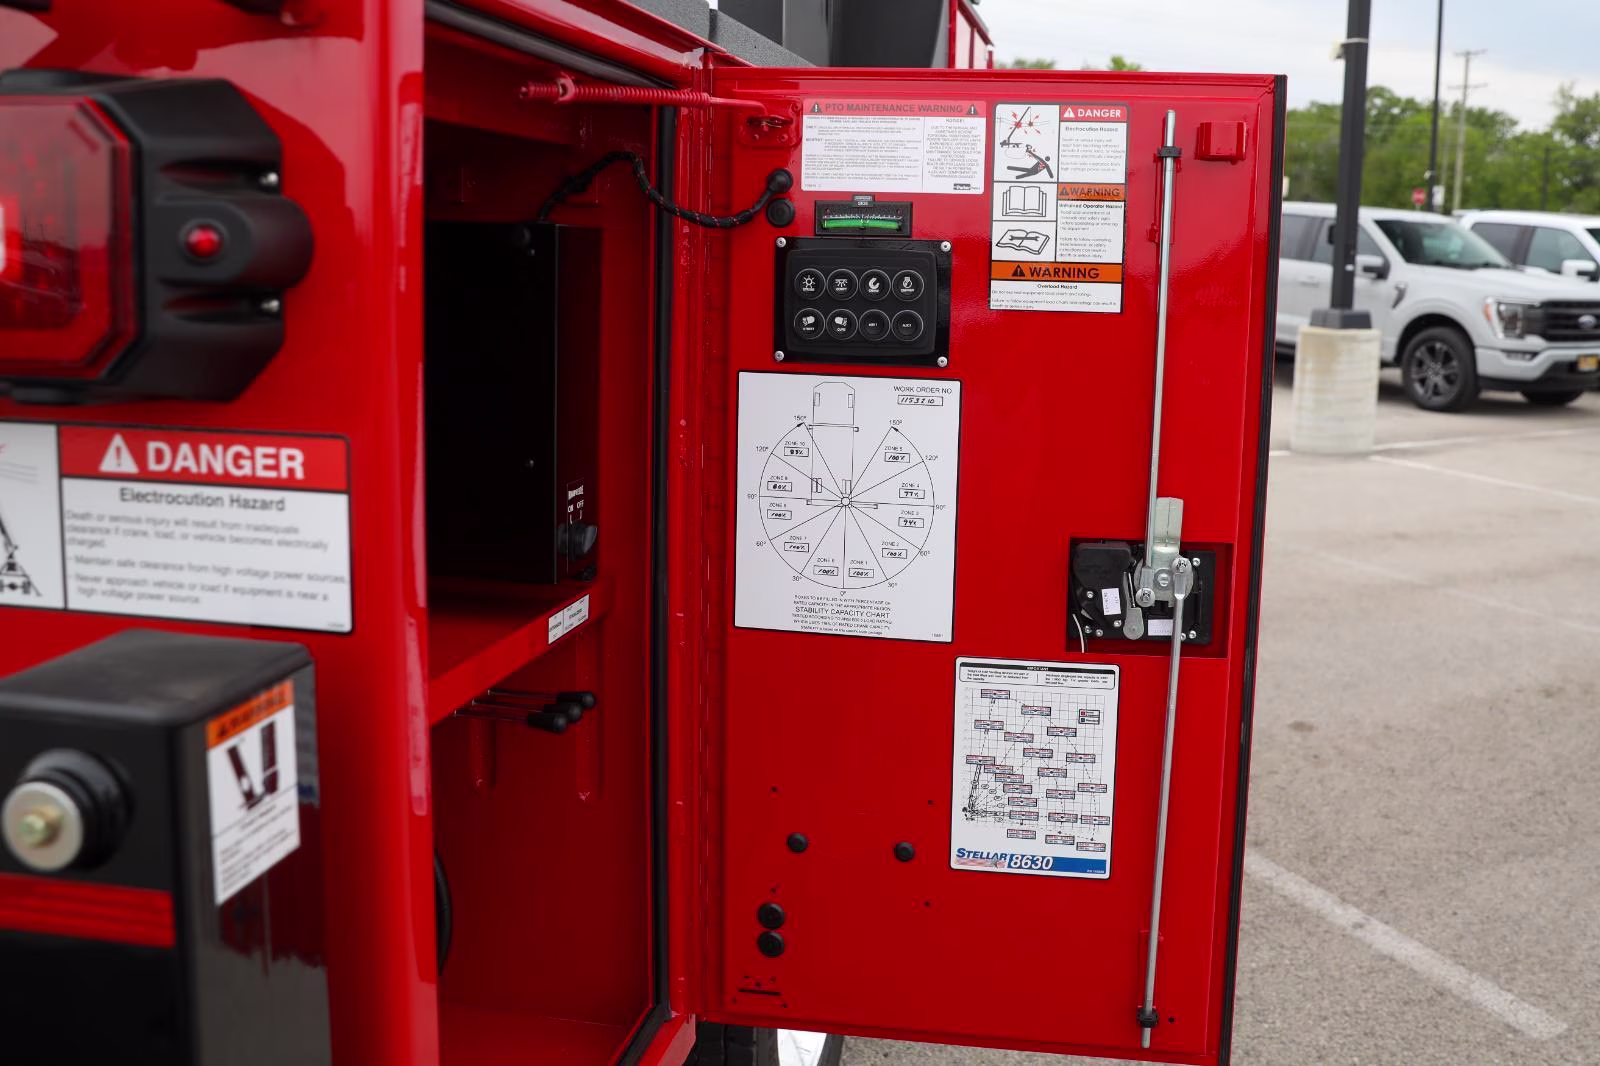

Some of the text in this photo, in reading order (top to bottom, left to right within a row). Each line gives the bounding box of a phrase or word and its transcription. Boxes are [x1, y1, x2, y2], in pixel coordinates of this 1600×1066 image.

[826, 102, 964, 114] PTO MAINTENANCE WARNING
[1077, 108, 1121, 118] DANGER
[1071, 188, 1120, 196] WARNING
[1029, 266, 1100, 279] WARNING
[147, 441, 305, 480] DANGER
[119, 487, 286, 512] Electrocution Hazard
[67, 510, 92, 522] Death
[109, 513, 142, 524] serious
[146, 516, 171, 528] injury
[174, 518, 188, 527] will
[192, 520, 218, 530] result
[221, 520, 242, 530] from
[246, 522, 300, 535] inadequate
[67, 524, 112, 536] clearance
[193, 532, 226, 542] vehicle
[230, 534, 274, 546] becomes
[277, 536, 329, 552] electrically
[75, 554, 112, 567] Maintain
[117, 558, 136, 568] safe
[140, 560, 184, 572] clearance
[188, 562, 210, 572] from
[212, 562, 231, 577] high
[236, 567, 270, 580] voltage
[273, 571, 304, 581] power
[76, 572, 102, 584] Never
[106, 576, 148, 590] approach
[152, 580, 186, 590] vehicle
[201, 582, 222, 593] load
[232, 586, 282, 598] equipment
[297, 590, 319, 600] near
[78, 586, 98, 600] high
[101, 588, 134, 602] voltage
[137, 592, 166, 604] power
[956, 848, 1054, 870] STELLAR 8630
